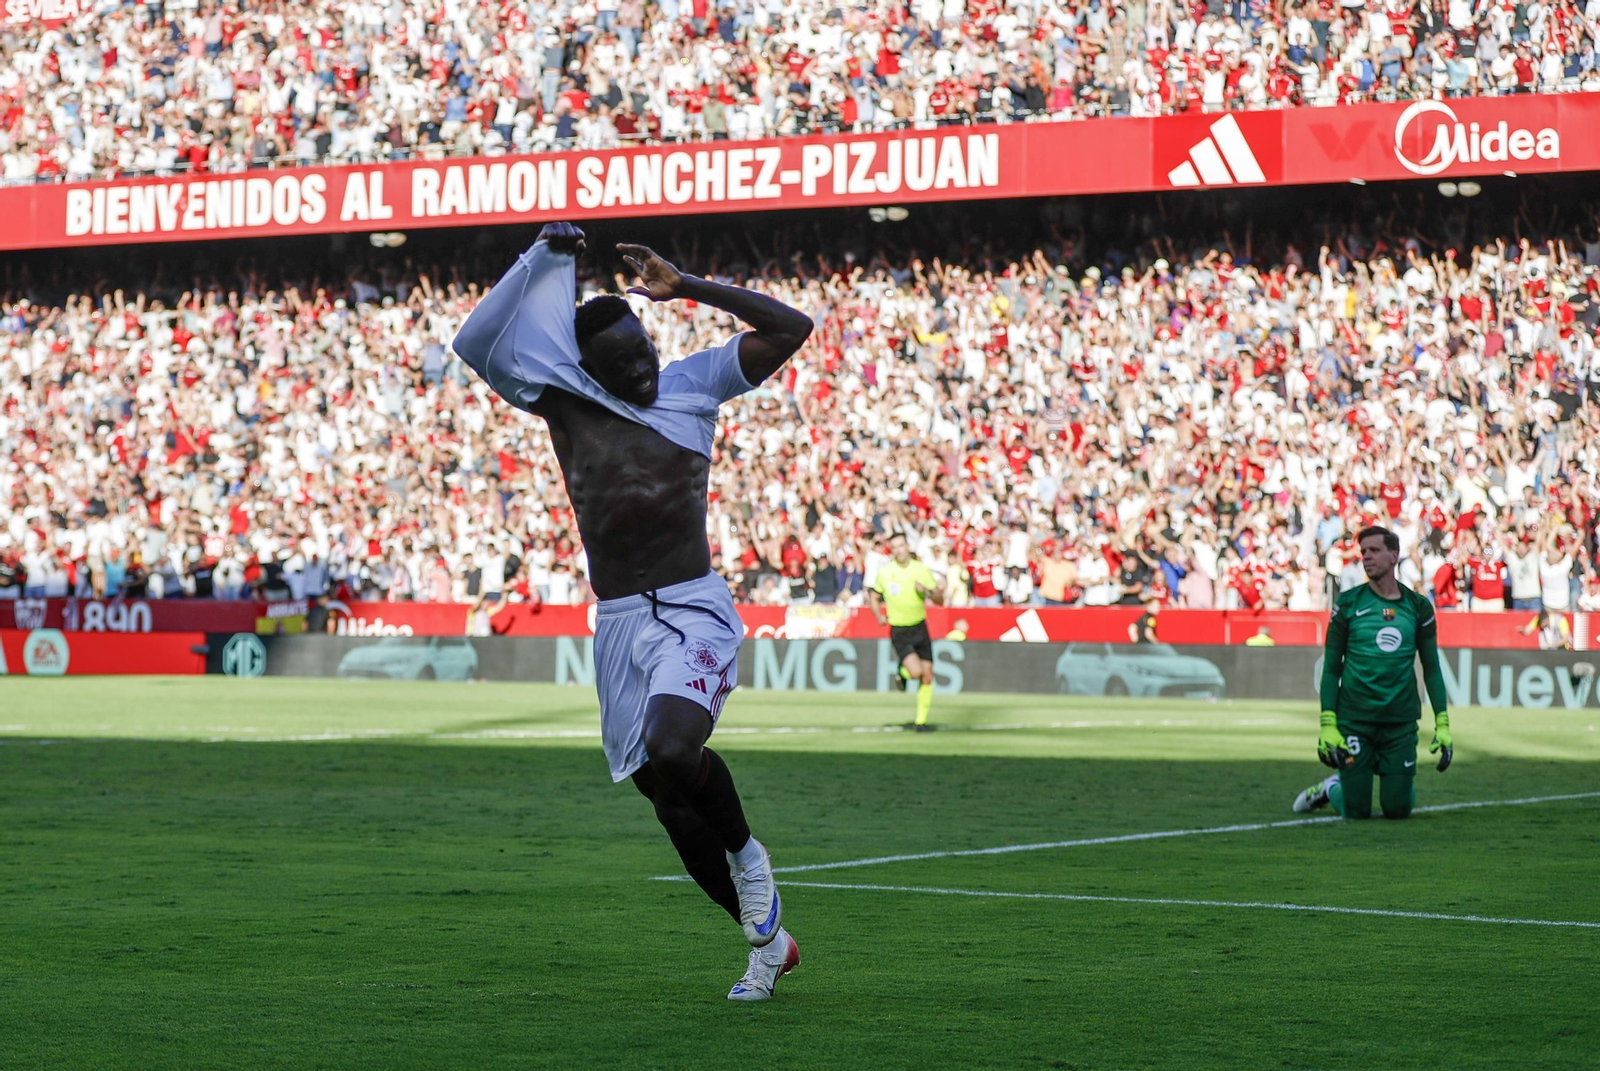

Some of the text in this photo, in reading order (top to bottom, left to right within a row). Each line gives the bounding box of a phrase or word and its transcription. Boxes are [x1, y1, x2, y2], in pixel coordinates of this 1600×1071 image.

[1418, 120, 1560, 166] Midea
[65, 134, 999, 237] BIENVENIDOS AL RAMON SANCHEZ-PIZJUAN
[753, 637, 859, 692] MG
[1424, 647, 1600, 710] Nuev
